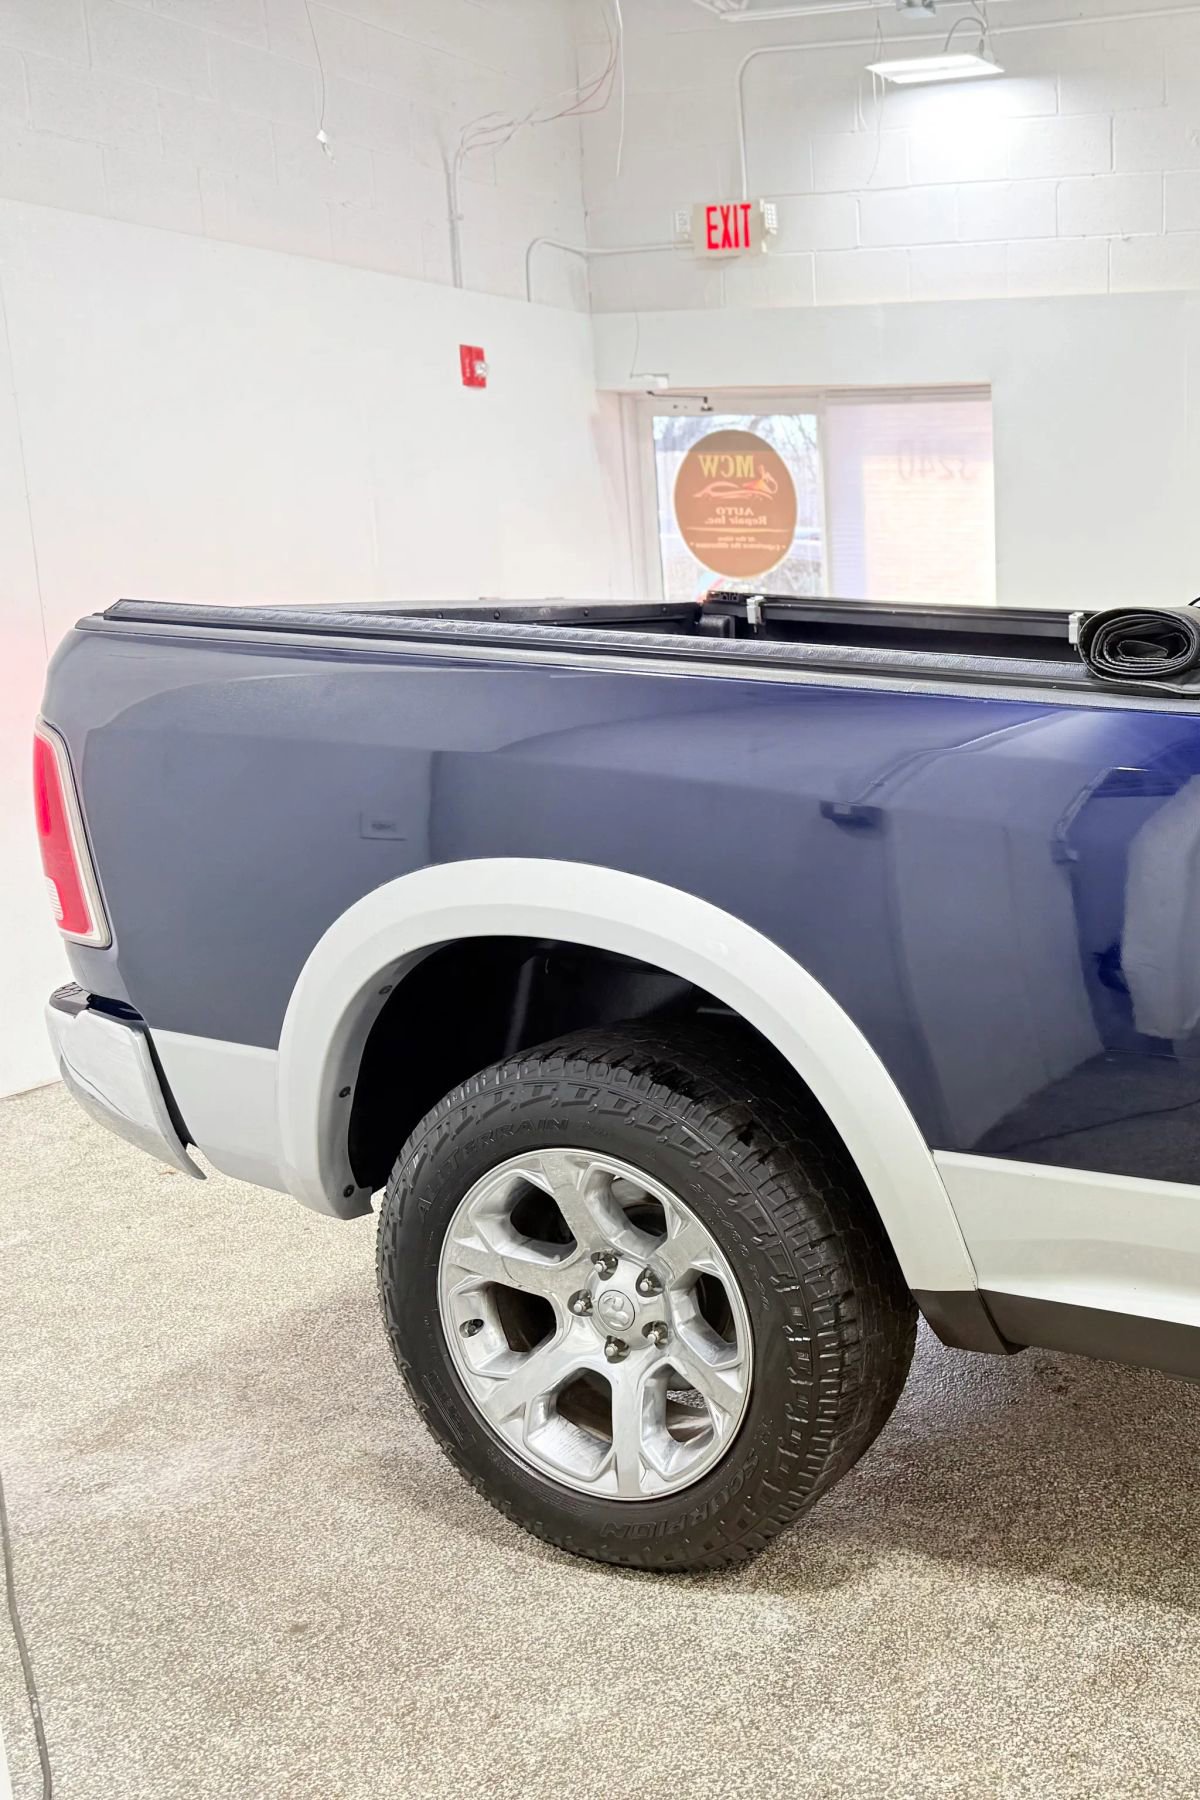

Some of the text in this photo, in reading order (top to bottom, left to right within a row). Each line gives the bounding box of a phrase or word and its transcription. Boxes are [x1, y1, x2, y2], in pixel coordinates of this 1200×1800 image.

[705, 203, 752, 250] EXIT
[444, 1117, 570, 1169] TERRAIN
[599, 1447, 761, 1541] SCORPION
